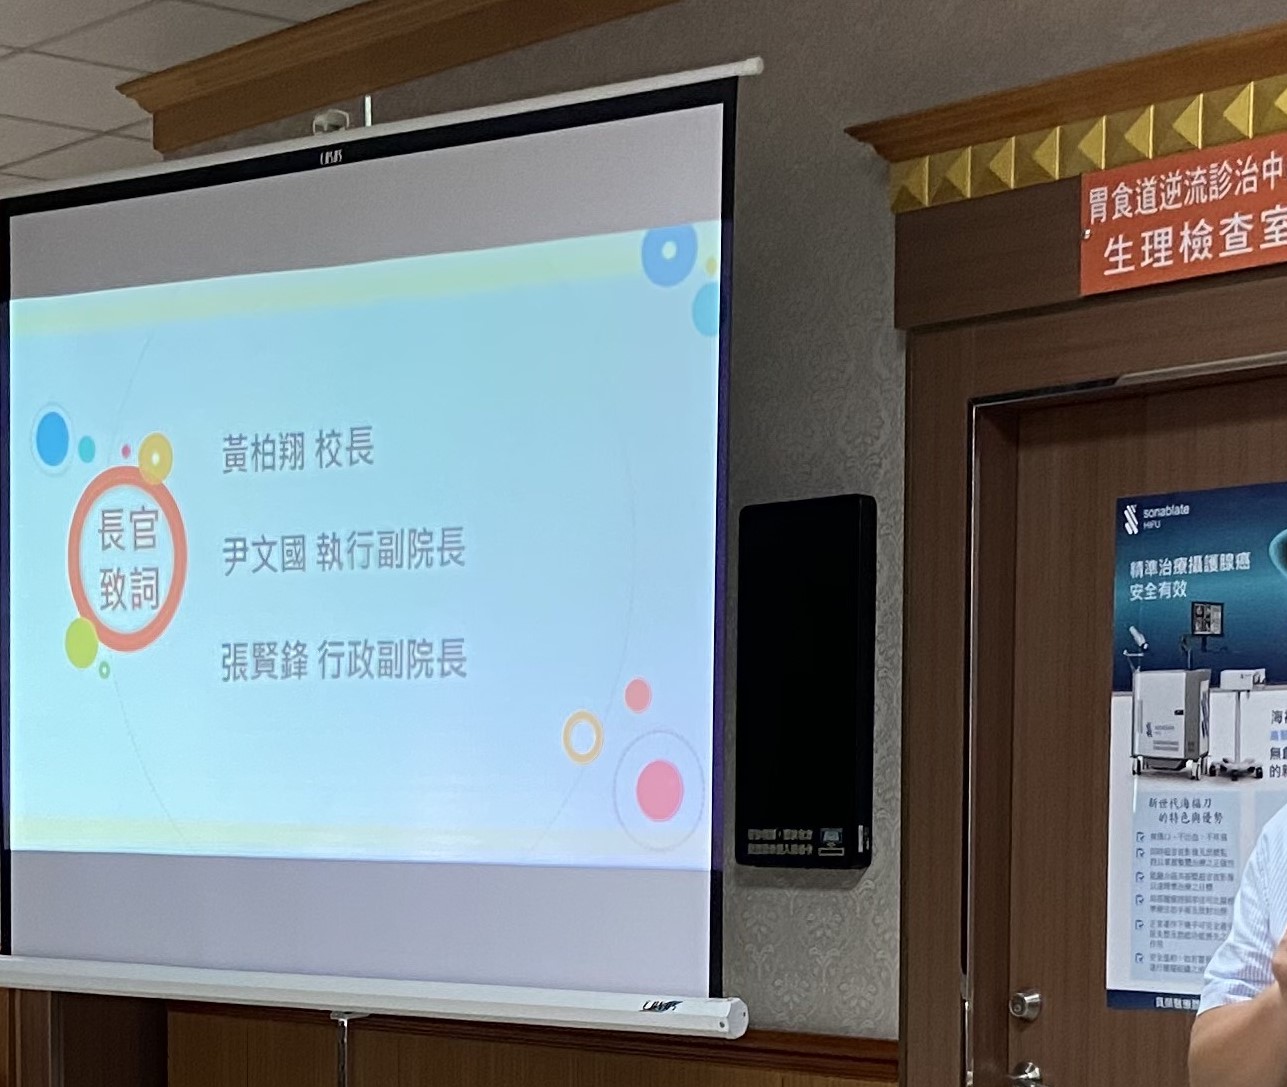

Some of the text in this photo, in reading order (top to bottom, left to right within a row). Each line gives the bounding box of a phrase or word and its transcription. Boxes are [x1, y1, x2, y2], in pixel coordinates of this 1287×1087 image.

[222, 425, 374, 474] 黃柏翔 校長
[97, 505, 159, 552] 長官
[222, 526, 466, 577] 尹文國 執行副院長
[1130, 552, 1251, 579] 精準治療攝護腺癌
[99, 566, 160, 612] 致詞
[1129, 580, 1187, 601] 安全有效
[317, 637, 467, 681] 行政副院長
[1149, 797, 1212, 809] 新世代海福刀
